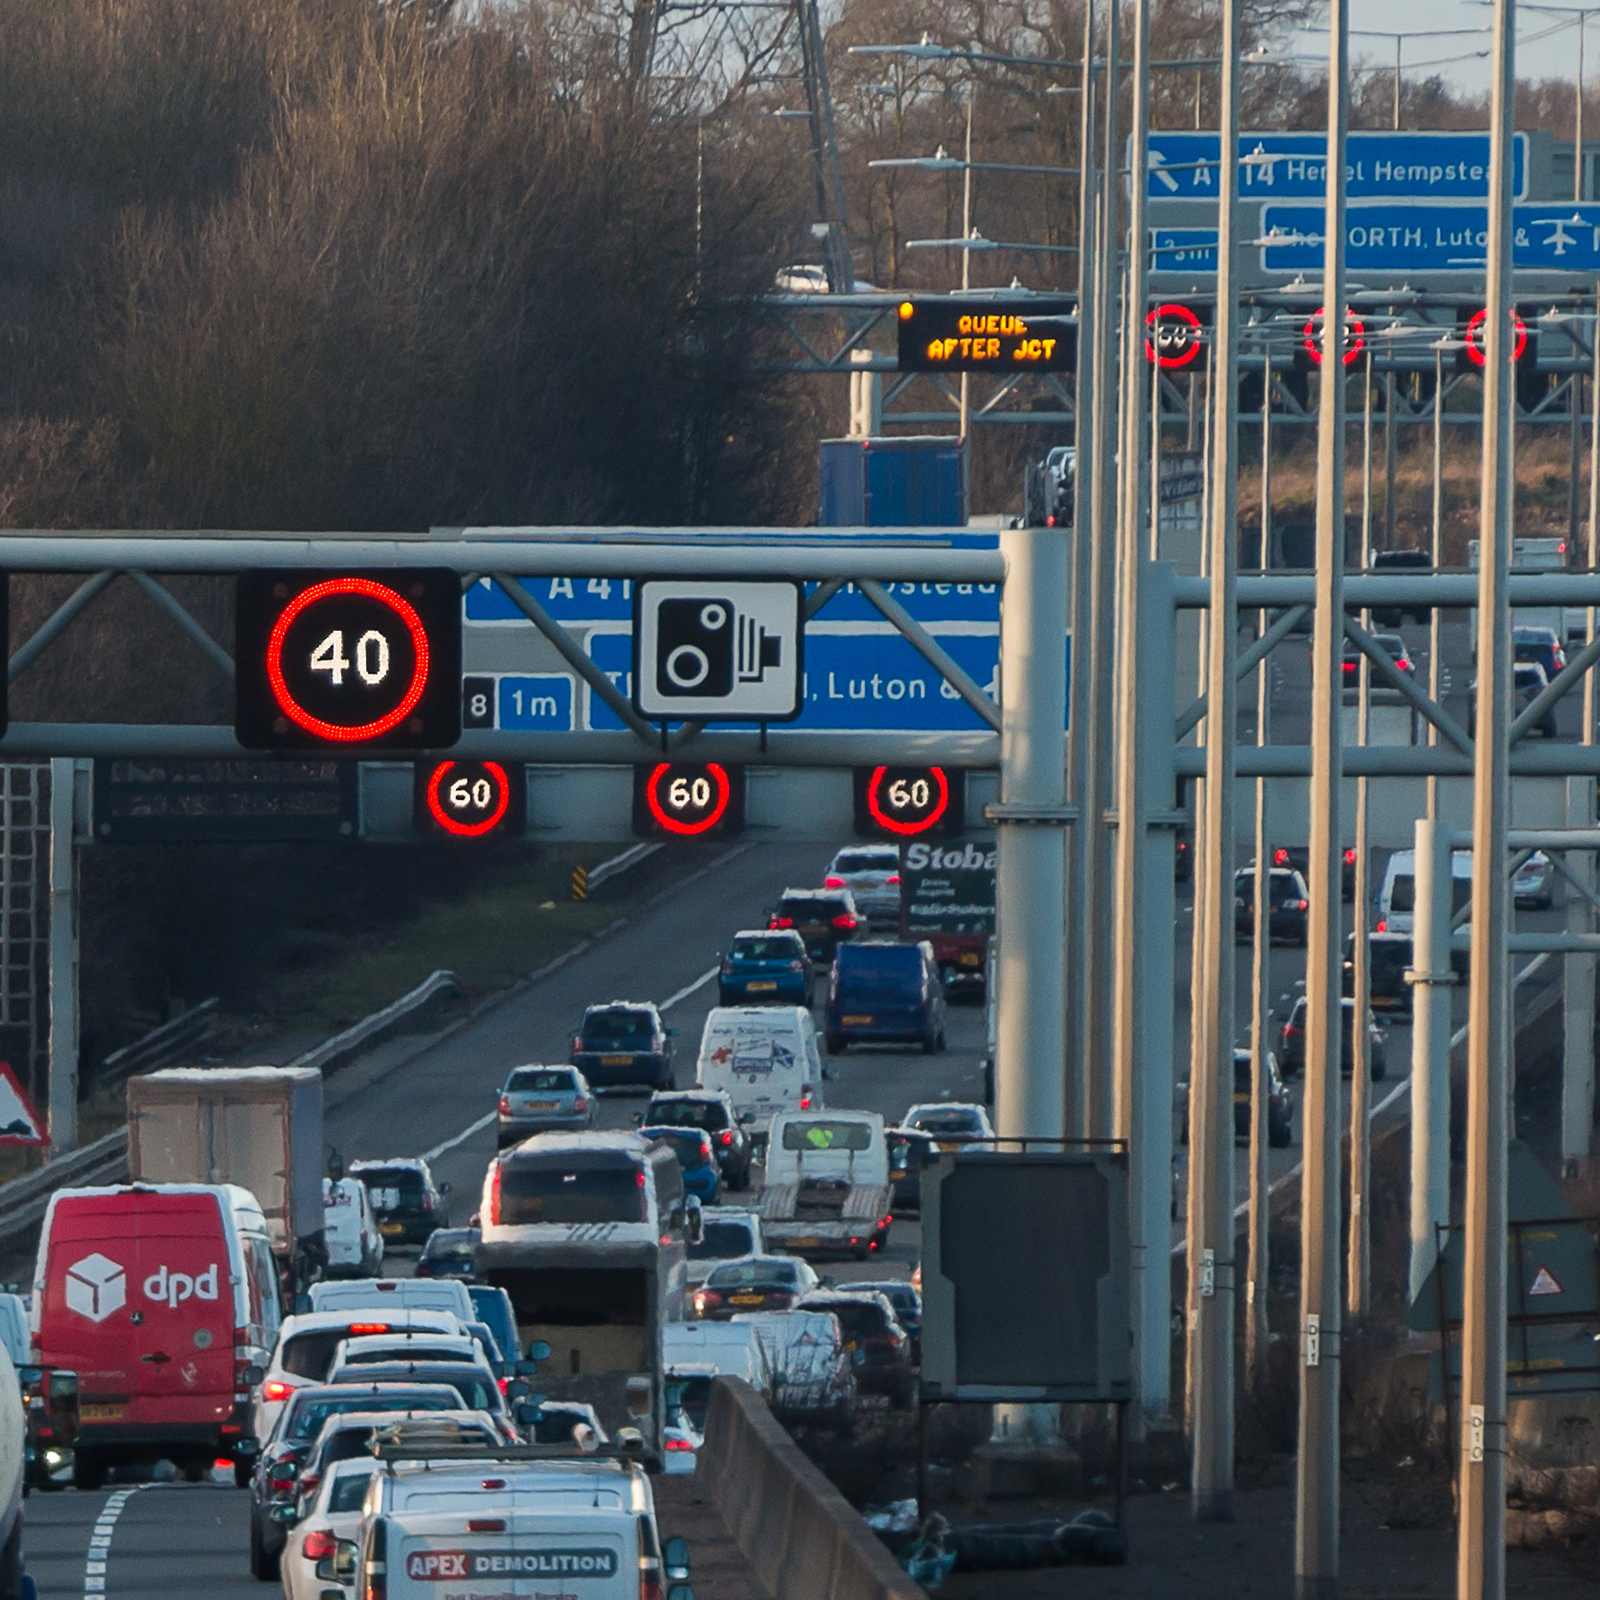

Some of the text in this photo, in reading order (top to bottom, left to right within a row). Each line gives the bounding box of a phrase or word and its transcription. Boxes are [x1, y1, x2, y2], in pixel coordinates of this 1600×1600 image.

[1288, 161, 1363, 182] Heel
[1375, 161, 1490, 184] Hempstea
[1350, 227, 1428, 250] ORTH,
[1436, 227, 1488, 247] Luto
[959, 315, 1028, 335] QUEUE
[927, 338, 1056, 361] AFTER JCT
[309, 628, 390, 686] 40
[829, 672, 926, 699] Luton
[470, 693, 488, 718] 8
[511, 689, 557, 717] 1m
[450, 777, 491, 807] 60
[669, 777, 710, 807] 60
[888, 778, 929, 808] 60
[906, 842, 997, 870] Stoba
[142, 1262, 219, 1309] dpd
[410, 1553, 612, 1577] APEX DEMOLITION
